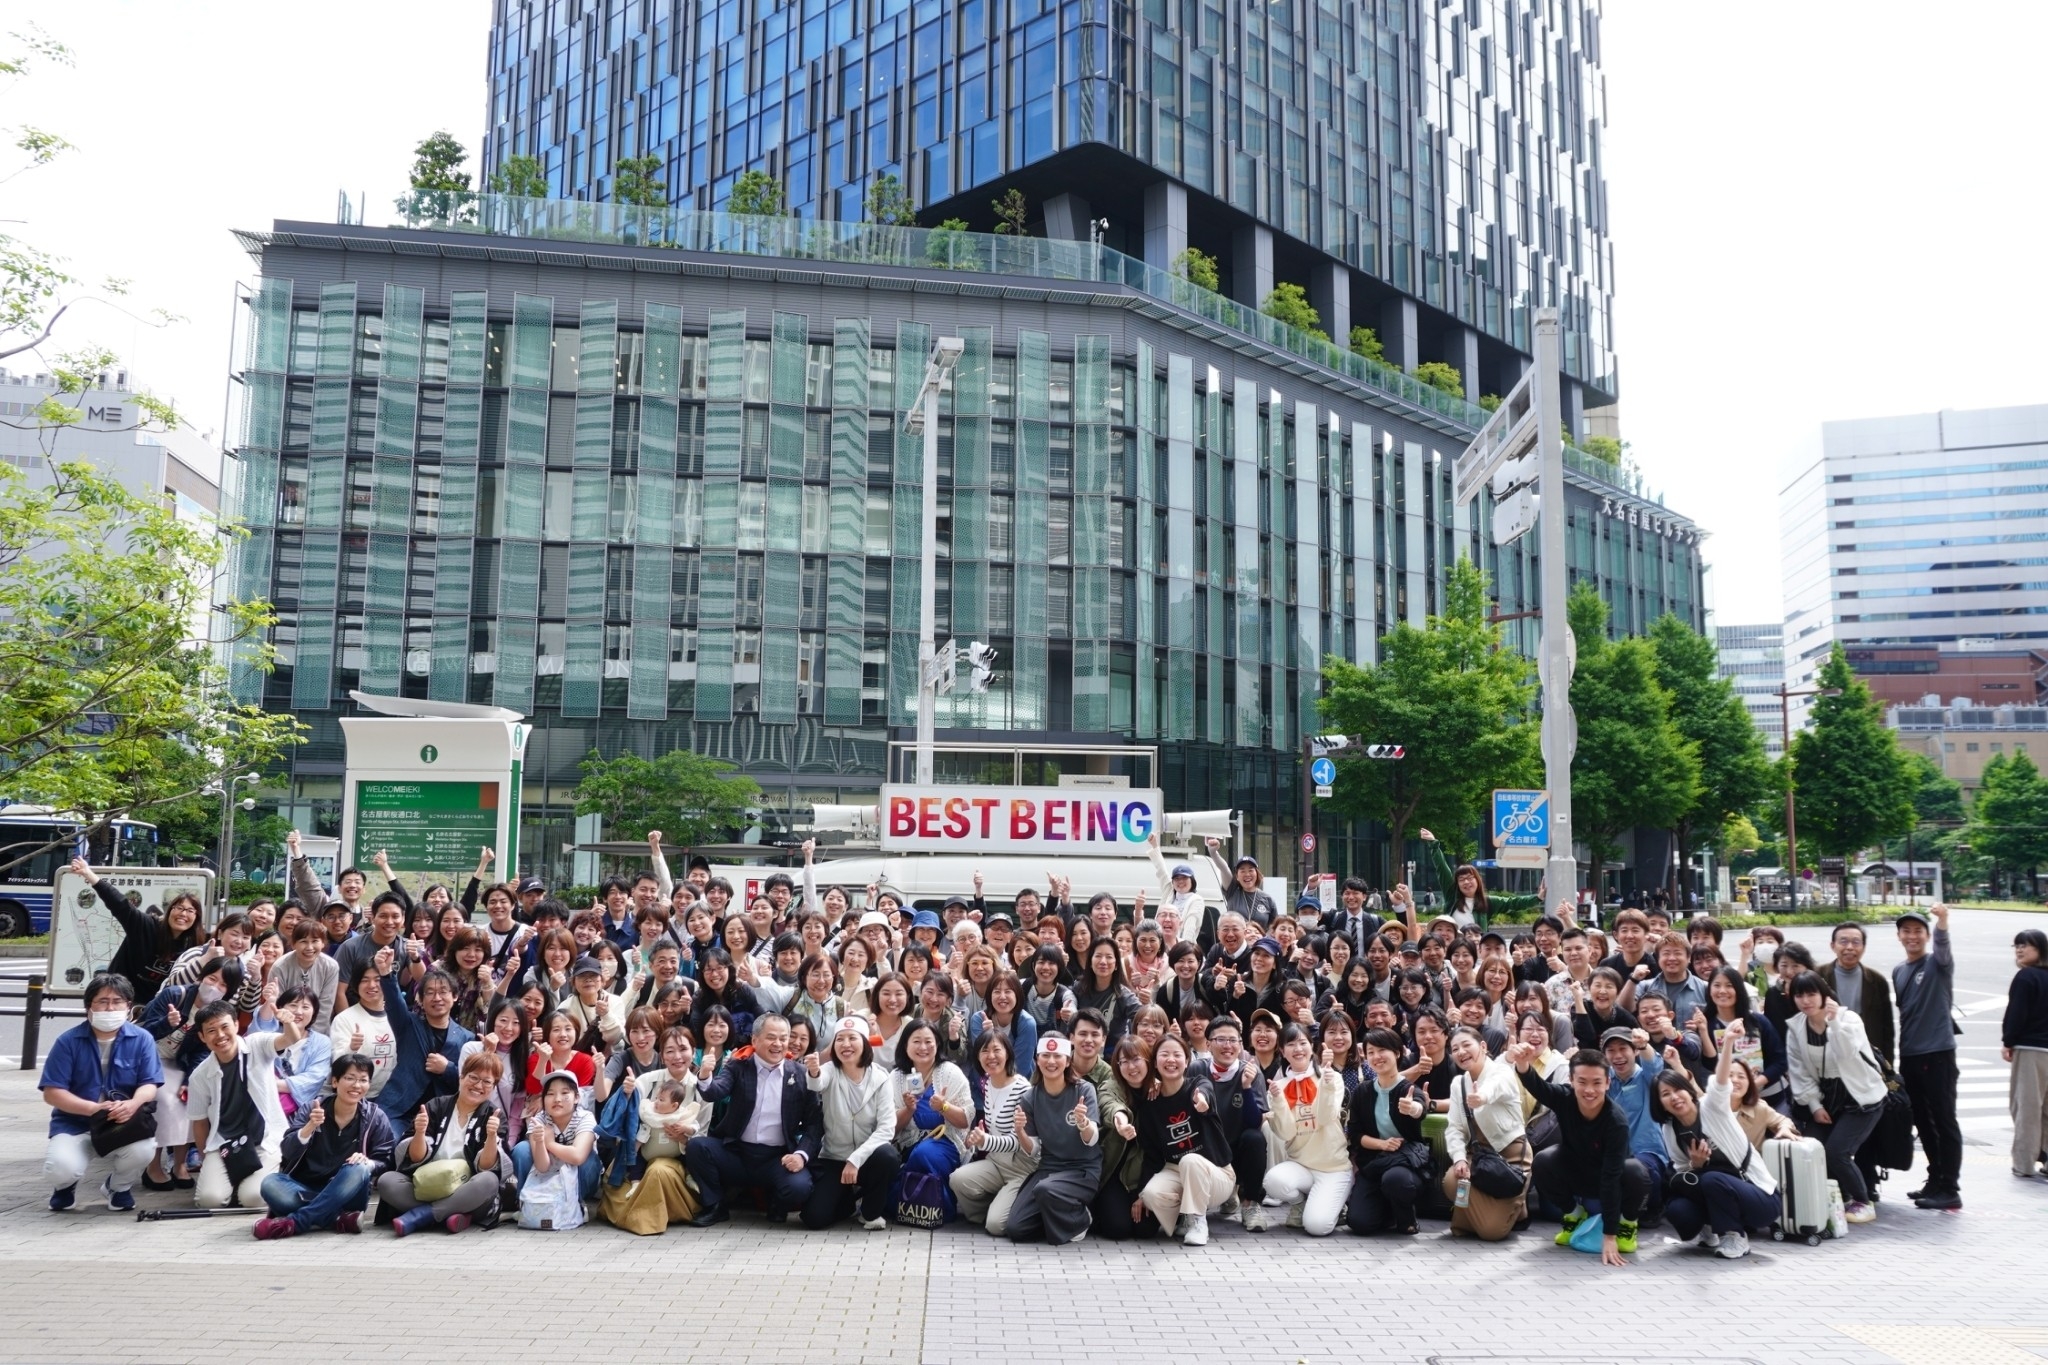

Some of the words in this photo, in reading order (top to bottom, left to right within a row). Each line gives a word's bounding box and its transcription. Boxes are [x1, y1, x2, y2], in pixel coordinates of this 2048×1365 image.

[801, 796, 833, 804] MAISON
[361, 810, 421, 819] 名古屋駅桜通口北
[889, 796, 1001, 839] BEST
[1009, 799, 1153, 843] BEING
